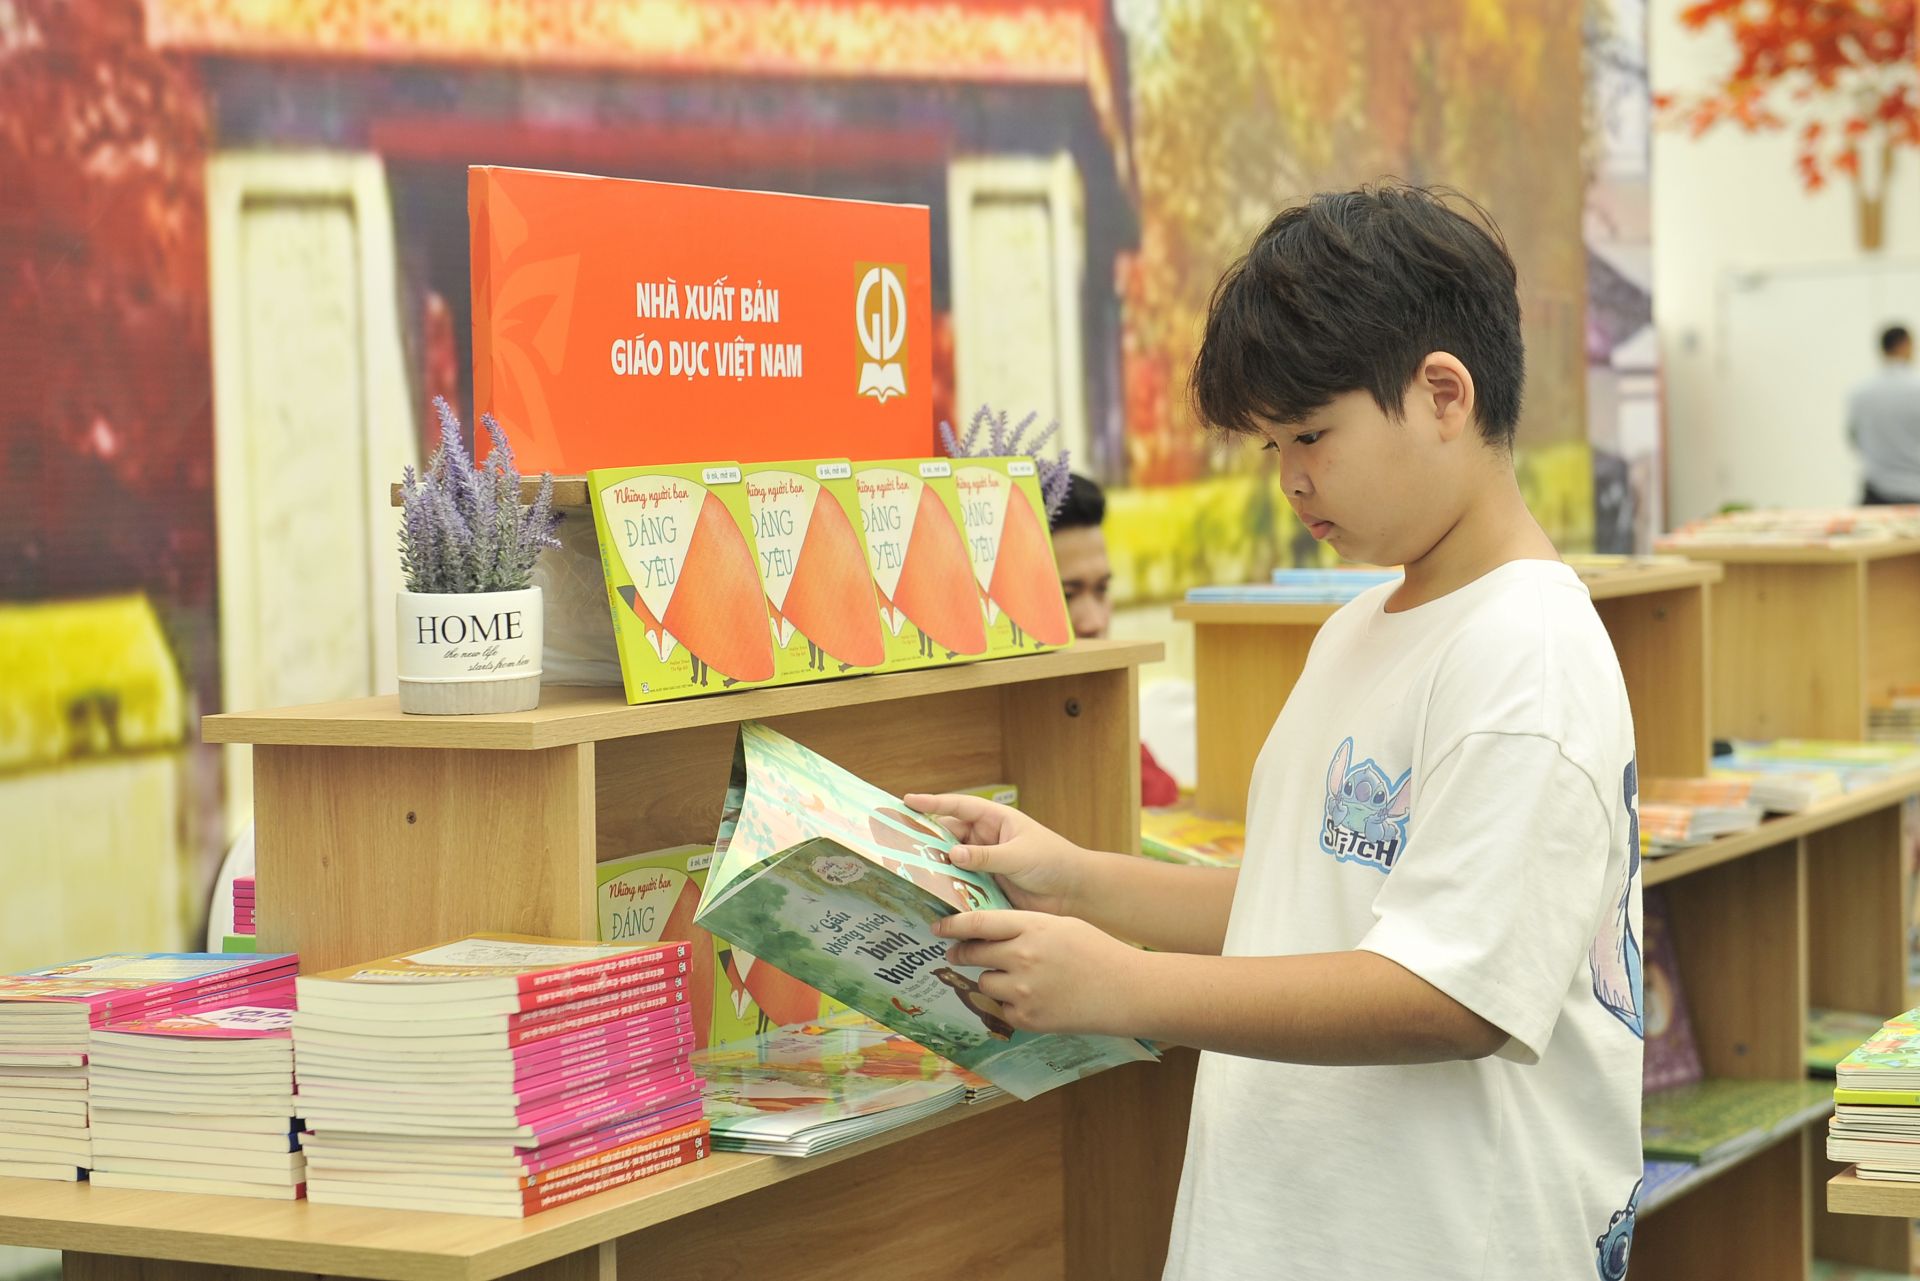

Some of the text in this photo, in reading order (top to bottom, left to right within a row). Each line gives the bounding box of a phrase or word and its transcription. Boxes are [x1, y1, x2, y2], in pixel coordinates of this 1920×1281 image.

[636, 275, 779, 323] NHÀ XUẤT BẢN
[611, 333, 802, 382] GIÁO DỤC VIỆT NAM
[614, 483, 689, 509] Những người bạn
[746, 478, 804, 503] hững người bạn
[856, 479, 875, 499] hững
[956, 475, 972, 496] hững
[624, 513, 677, 547] ĐÁNG
[761, 547, 793, 578] YÊU
[872, 541, 902, 570] YÊU
[970, 535, 995, 563] YÊU
[640, 555, 676, 588] YÊU
[416, 610, 523, 644] HOME
[443, 647, 459, 658] the
[608, 873, 672, 902] Những người bạn
[611, 906, 655, 940] ĐÁNG
[819, 910, 852, 933] Gấu
[822, 912, 895, 956] không thích
